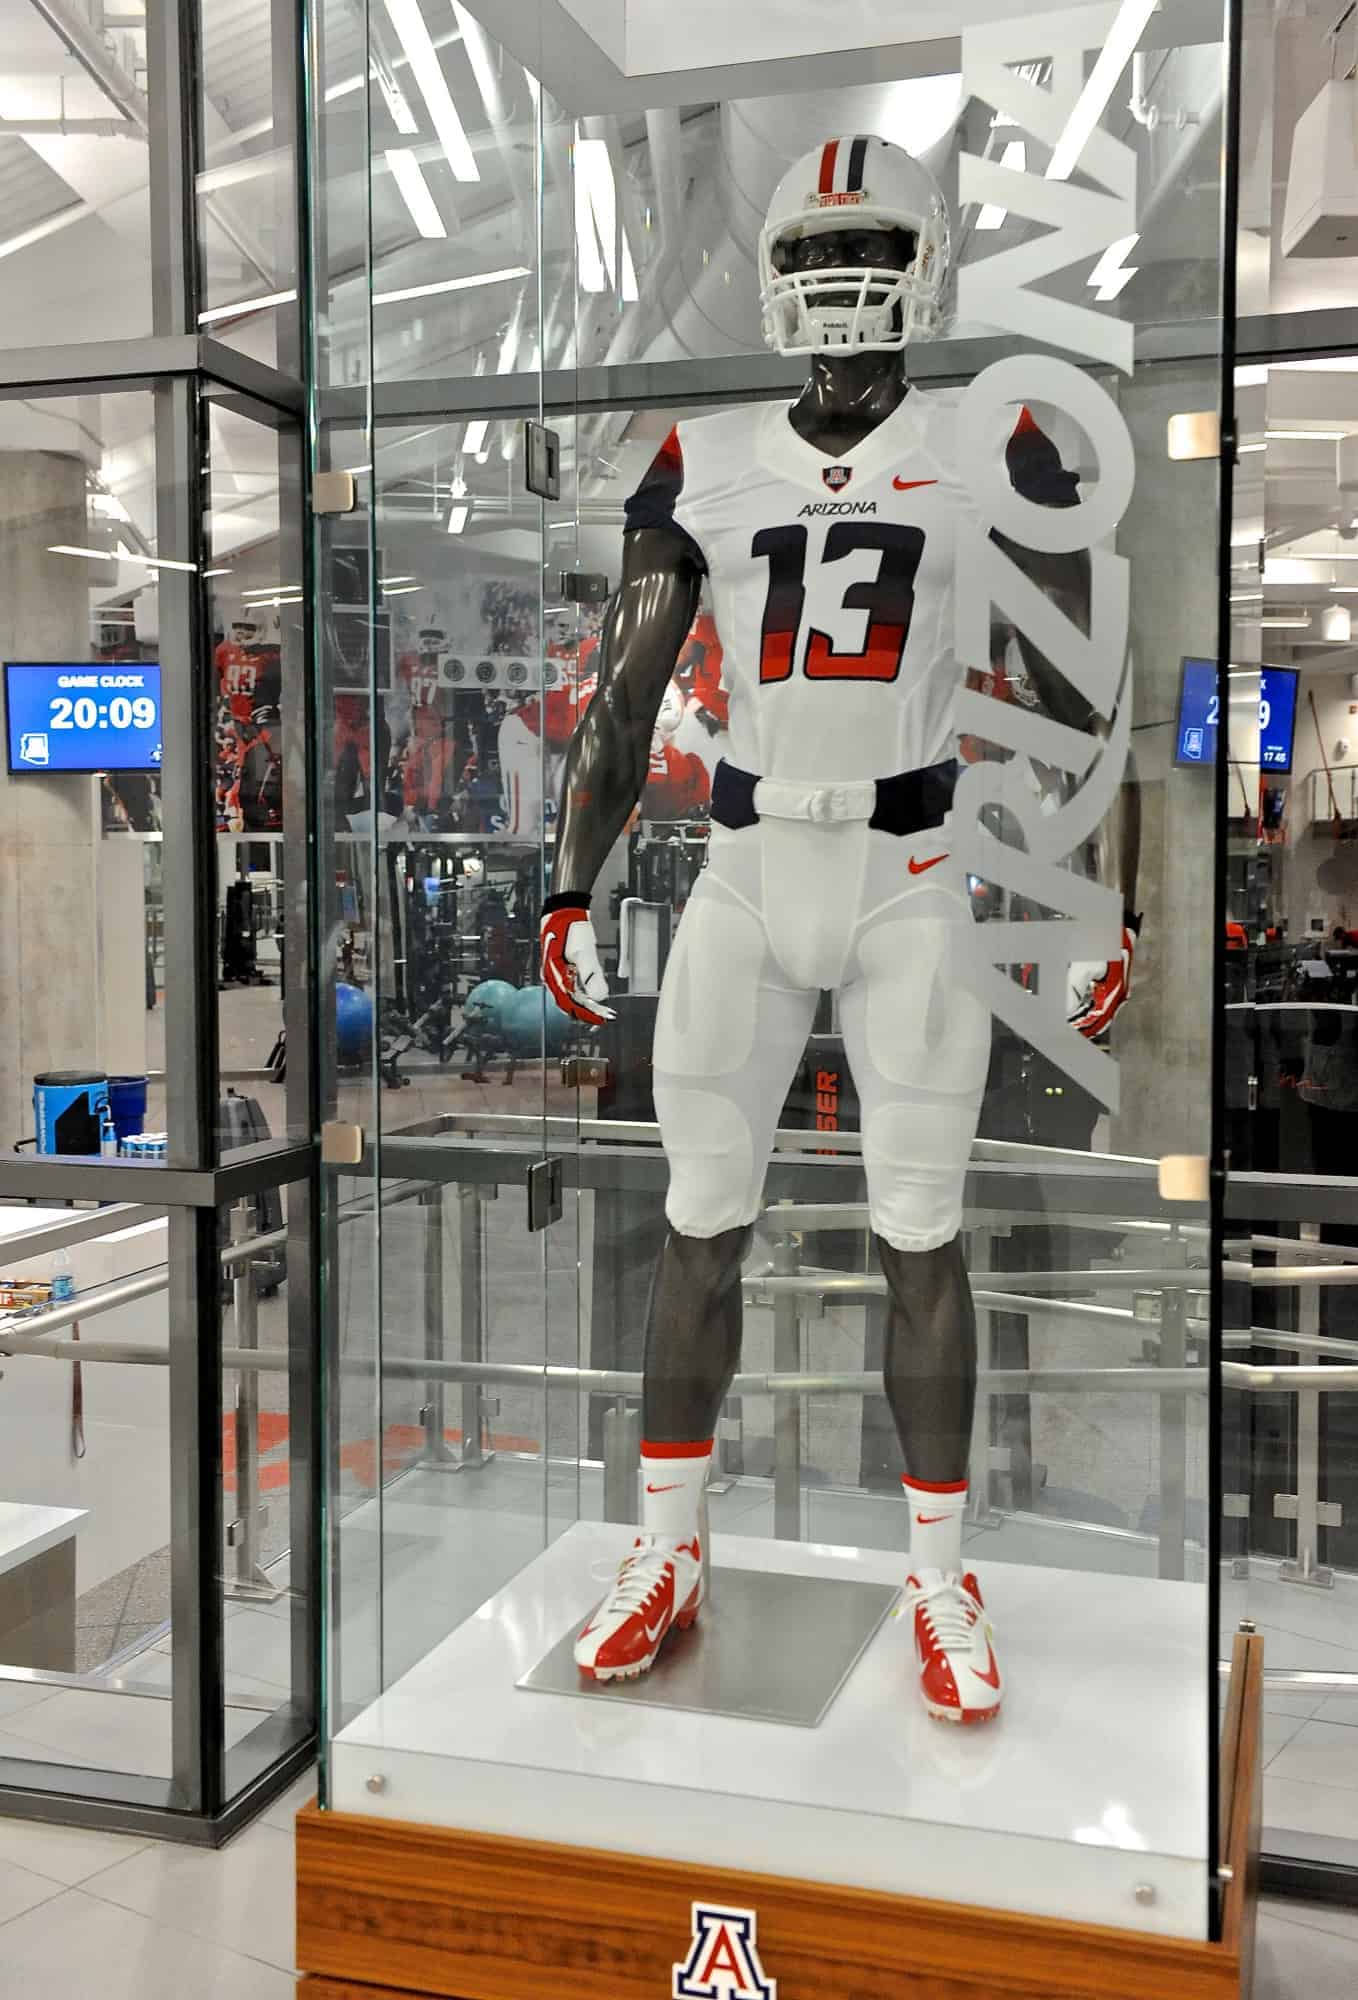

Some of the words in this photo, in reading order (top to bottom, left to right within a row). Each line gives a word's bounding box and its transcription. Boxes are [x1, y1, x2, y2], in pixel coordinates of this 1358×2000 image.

[797, 501, 877, 517] ARIZONA
[954, 0, 1138, 1117] ARIZONA
[751, 521, 926, 684] 13
[49, 697, 156, 730] 20:09
[57, 675, 99, 688] GAME
[100, 675, 145, 688] CLOCK
[673, 1902, 777, 2000] A
